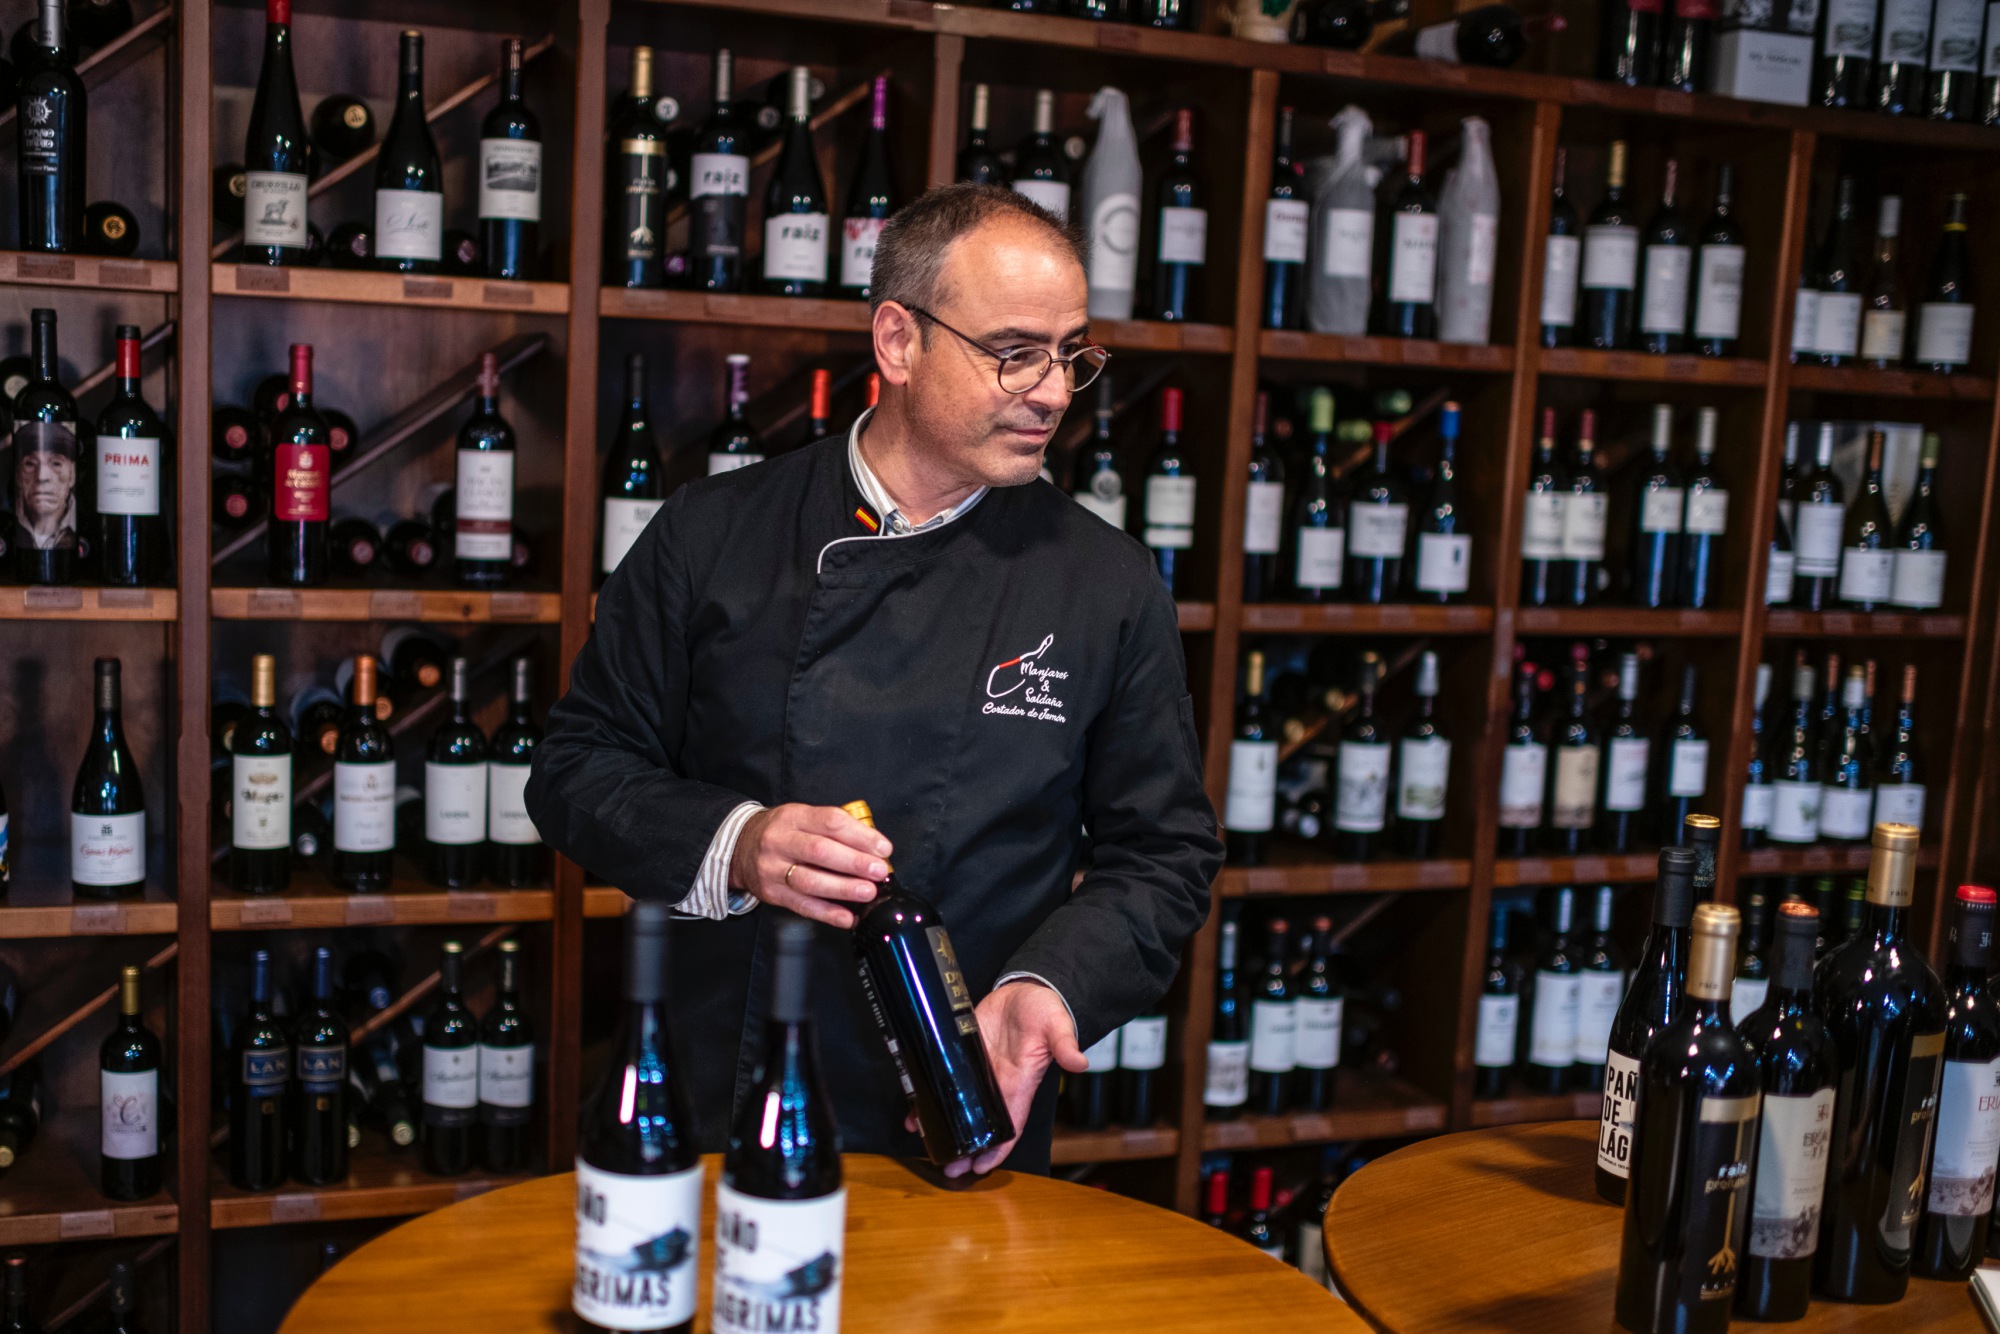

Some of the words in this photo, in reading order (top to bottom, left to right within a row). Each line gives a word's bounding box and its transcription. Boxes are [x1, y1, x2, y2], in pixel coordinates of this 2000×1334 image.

[105, 453, 150, 467] PRIMA
[1020, 661, 1069, 682] Manjares
[1040, 679, 1050, 692] &
[982, 702, 1026, 715] Cortador
[1027, 708, 1038, 718] de
[1038, 708, 1066, 723] Jamón
[303, 1058, 340, 1070] LAN
[1604, 1094, 1622, 1127] DE
[1600, 1125, 1629, 1162] LÁG
